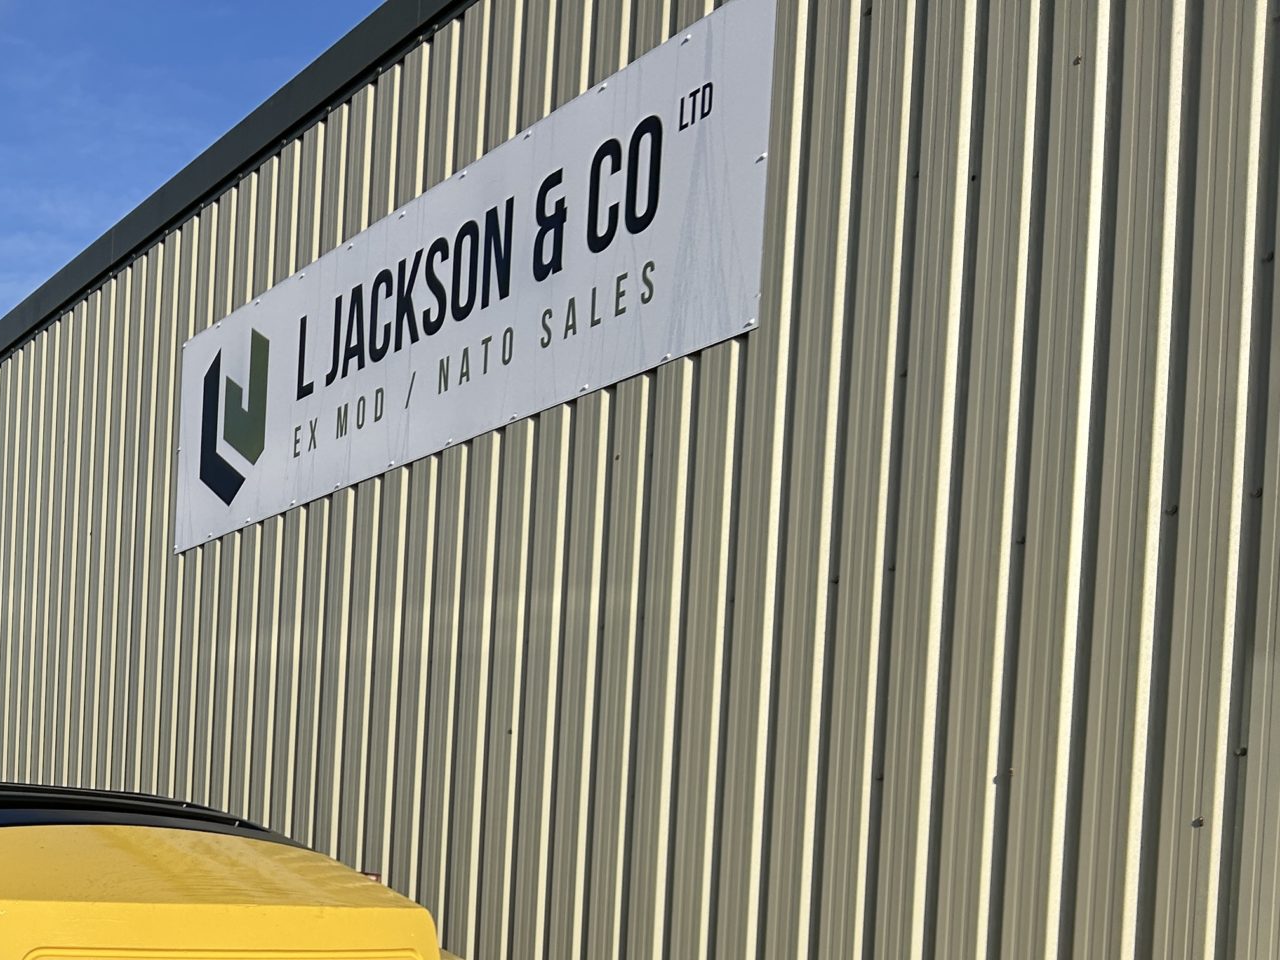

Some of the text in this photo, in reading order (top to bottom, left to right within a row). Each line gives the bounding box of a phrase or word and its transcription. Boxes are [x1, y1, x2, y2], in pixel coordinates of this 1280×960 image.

[293, 260, 656, 458] EX MOD / NATO SALES
[296, 81, 714, 401] L JACKSON & CO LTD
